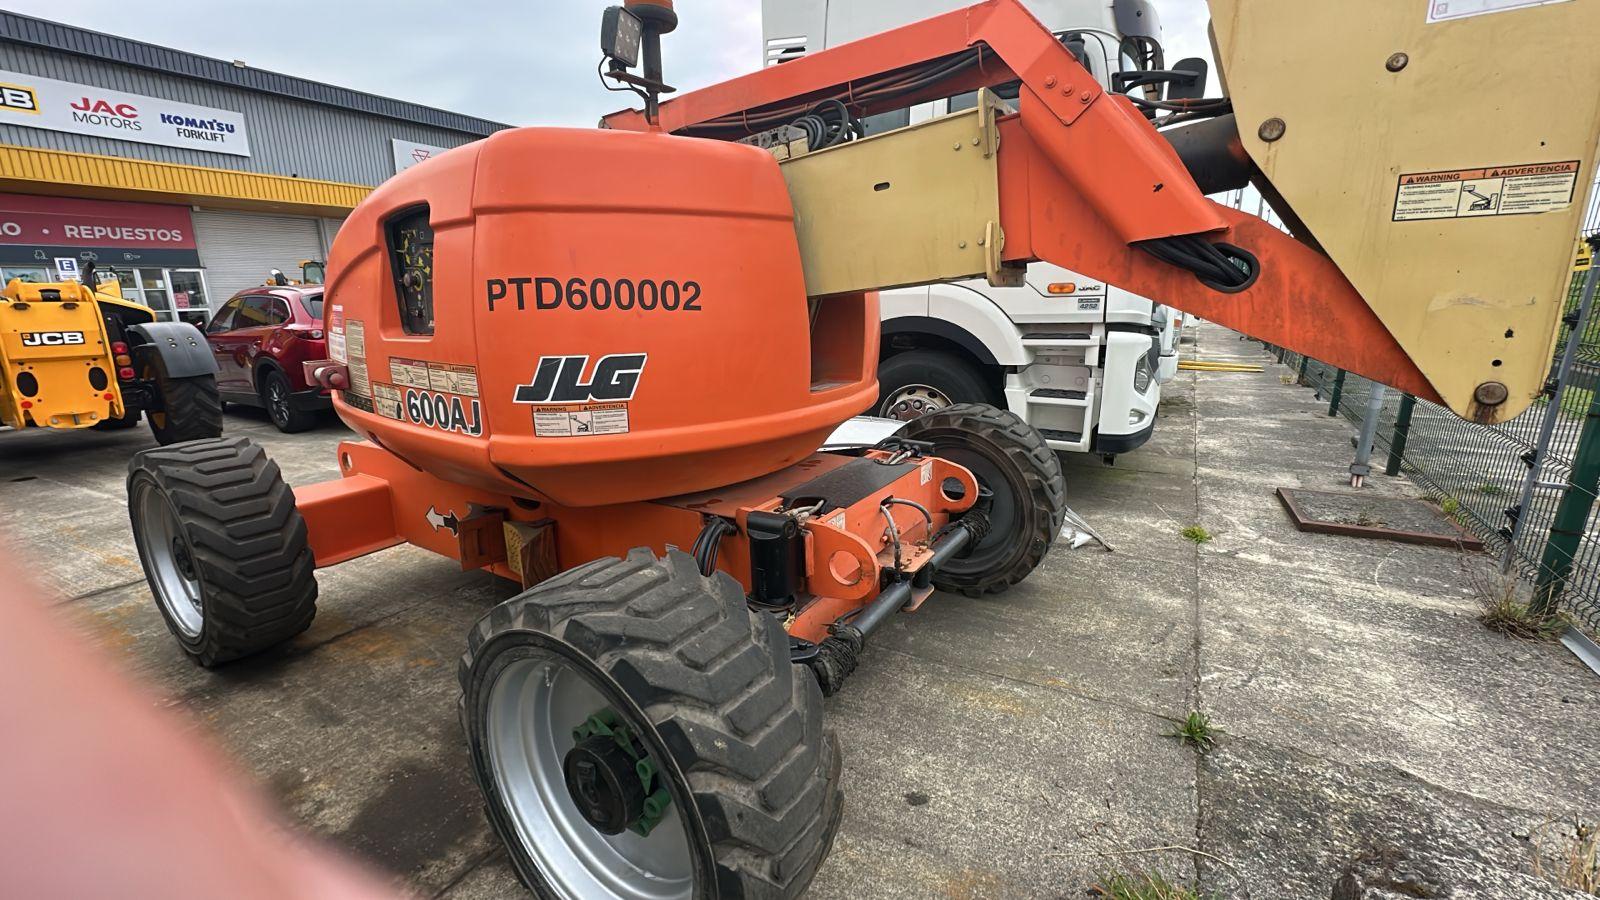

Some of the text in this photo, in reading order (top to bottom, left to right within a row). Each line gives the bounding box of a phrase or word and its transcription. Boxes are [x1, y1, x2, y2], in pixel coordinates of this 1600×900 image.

[0, 88, 34, 108] B
[70, 97, 138, 118] JAC
[72, 111, 142, 131] MOTORS
[160, 113, 235, 134] KOMATSU
[177, 127, 226, 143] FORKLIFT
[1416, 173, 1461, 183] WARNING
[1501, 164, 1571, 176] ADVERTENCIA
[0, 222, 21, 236] O
[63, 224, 183, 242] REPUESTOS
[62, 260, 72, 270] E
[486, 277, 702, 311] PTD600002
[23, 332, 84, 346] JCB
[513, 353, 648, 403] JLG
[406, 389, 482, 436] 600AJ
